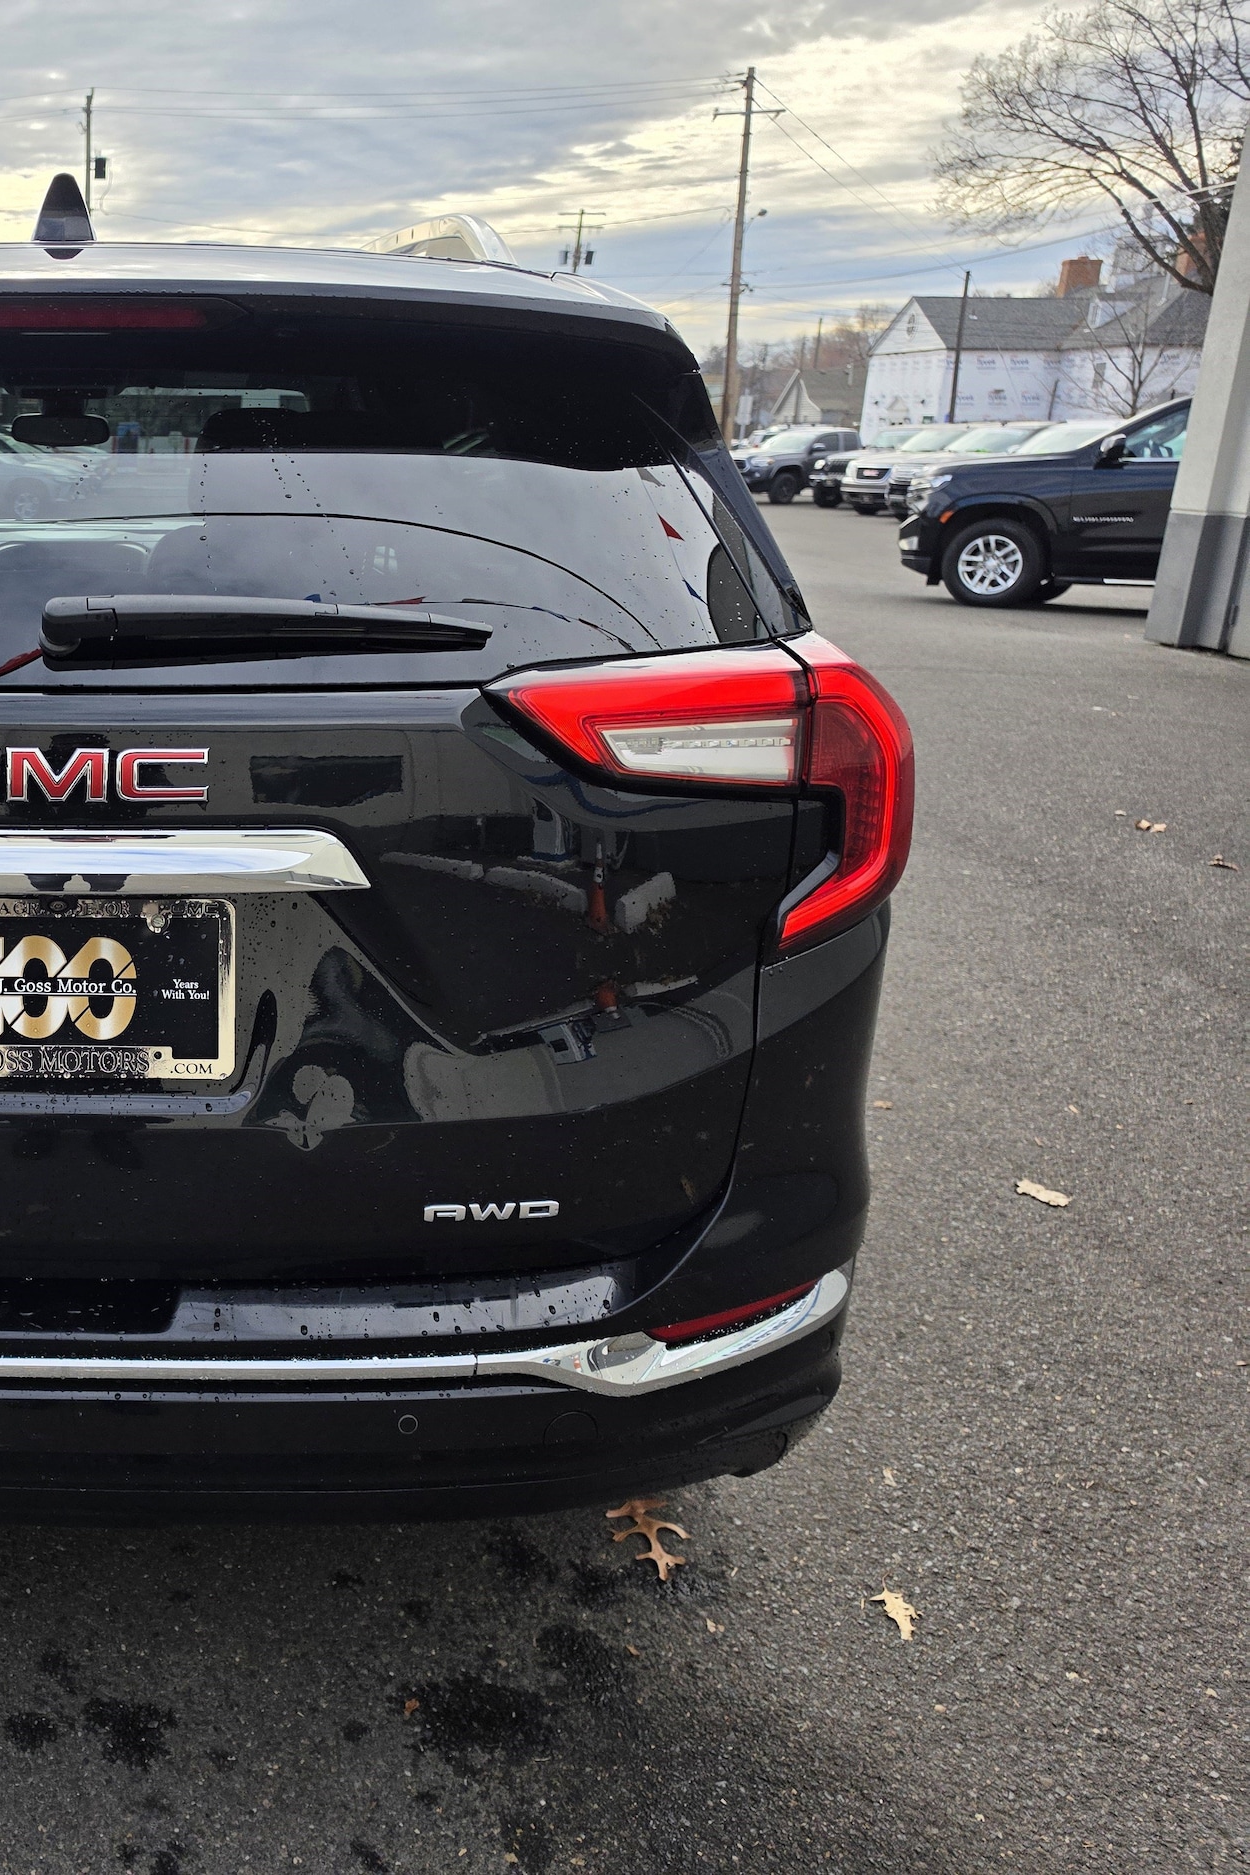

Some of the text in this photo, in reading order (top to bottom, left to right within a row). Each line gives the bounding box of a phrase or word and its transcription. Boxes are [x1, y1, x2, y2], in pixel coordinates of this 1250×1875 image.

[14, 978, 52, 993] Goss
[56, 978, 106, 993] Motor
[111, 979, 137, 994] Co.
[172, 978, 199, 989] Years
[161, 989, 210, 1000] With You!
[38, 1049, 150, 1073] MOTORS
[170, 1062, 213, 1075] .COM
[423, 1200, 560, 1223] AWD
